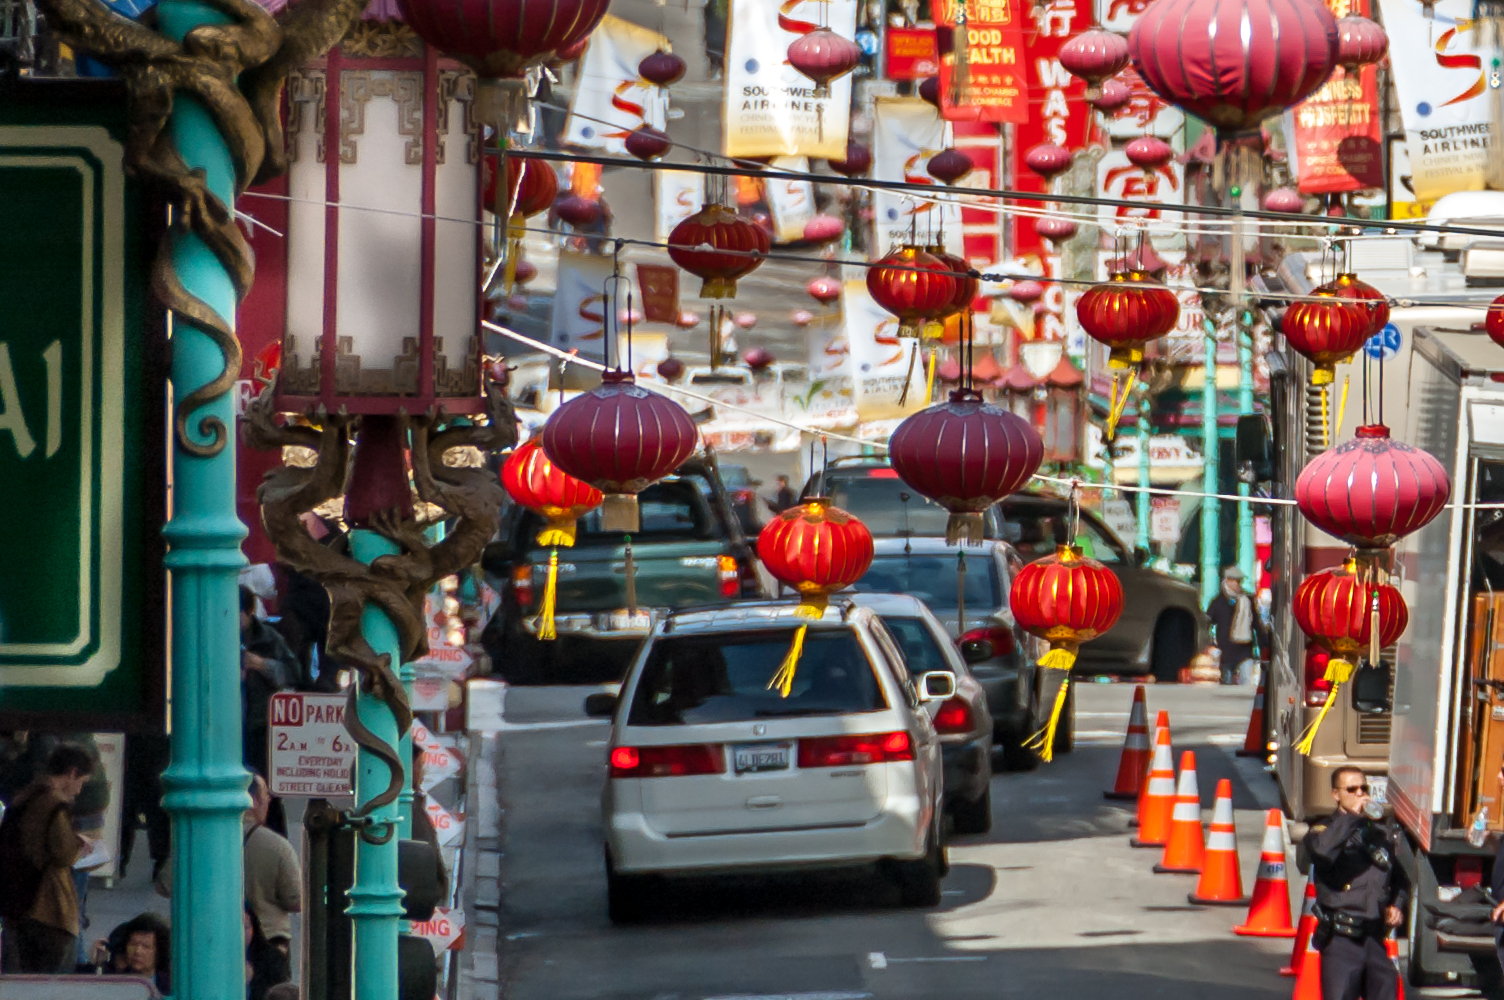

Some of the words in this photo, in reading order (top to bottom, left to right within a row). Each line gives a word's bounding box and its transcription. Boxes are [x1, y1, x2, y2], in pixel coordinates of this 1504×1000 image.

[968, 30, 1002, 46] OOD
[1306, 80, 1363, 102] SINESS
[1420, 123, 1492, 141] SOUTHWES
[1423, 137, 1489, 155] AIRLINE
[273, 697, 301, 724] NO
[306, 704, 345, 724] PARK
[323, 768, 350, 779] HOLID
